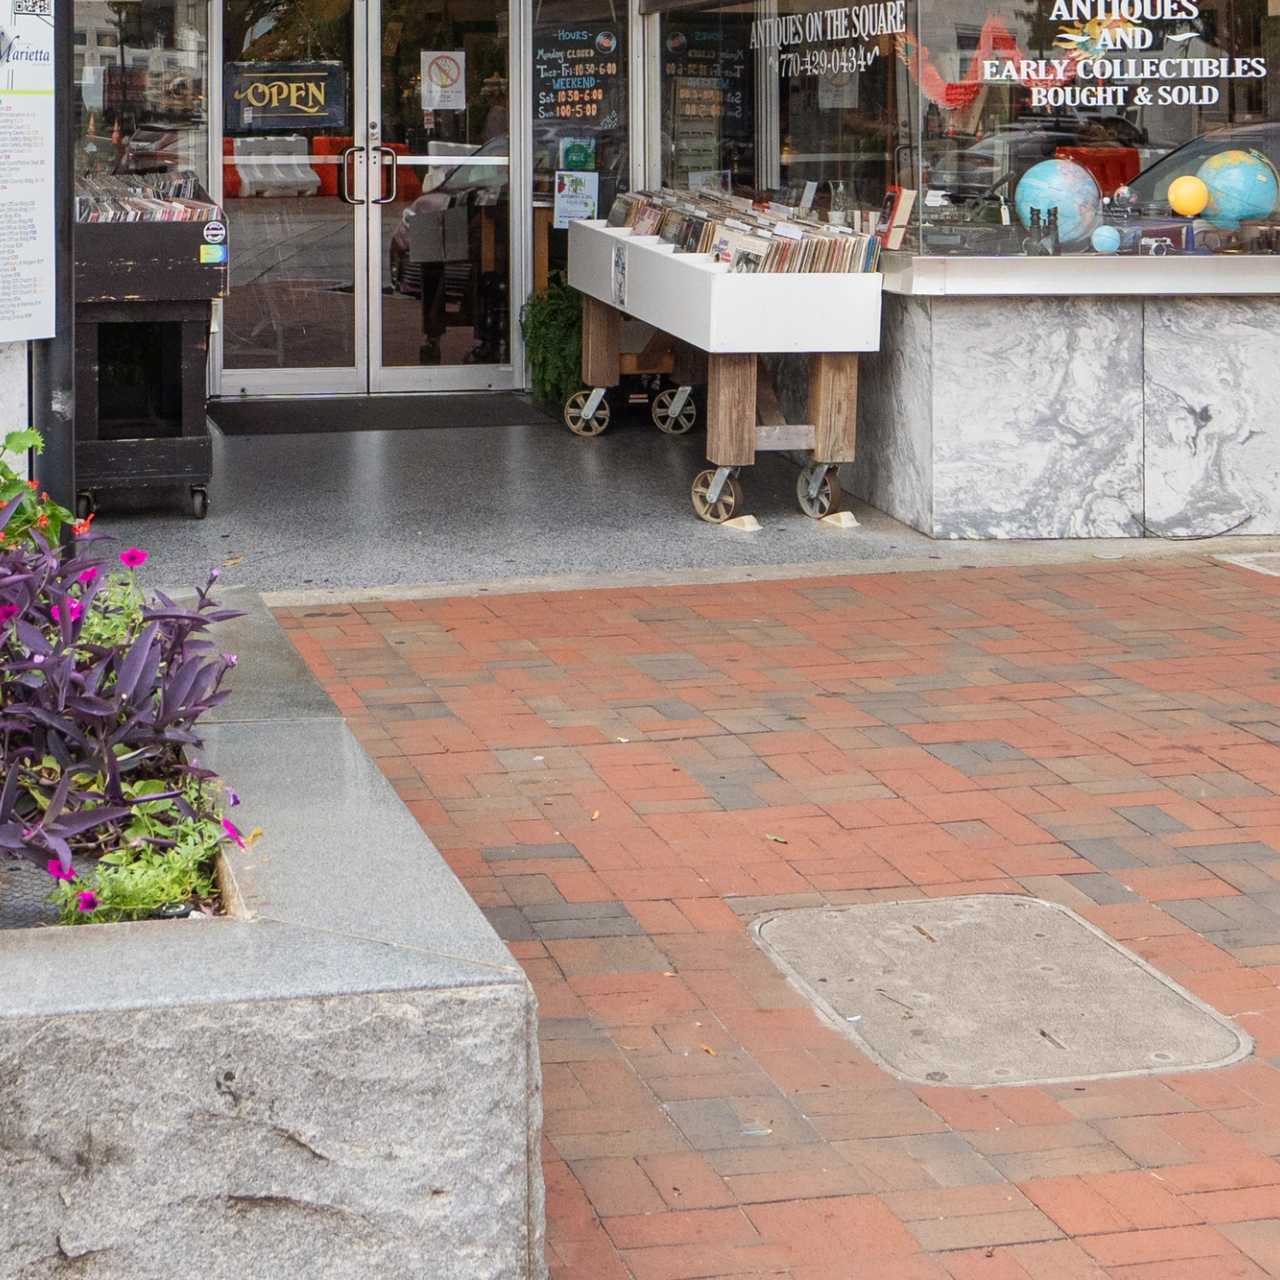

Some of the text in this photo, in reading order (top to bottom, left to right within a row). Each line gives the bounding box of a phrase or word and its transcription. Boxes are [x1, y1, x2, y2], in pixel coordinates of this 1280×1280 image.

[749, 0, 906, 50] ANTIQUES ON THE SQUARE
[1099, 27, 1154, 50] AND
[983, 57, 1267, 81] EARLY COLLECTIBLES
[233, 81, 326, 113] OPEN
[1031, 85, 1220, 107] BOUGHT & SOLD
